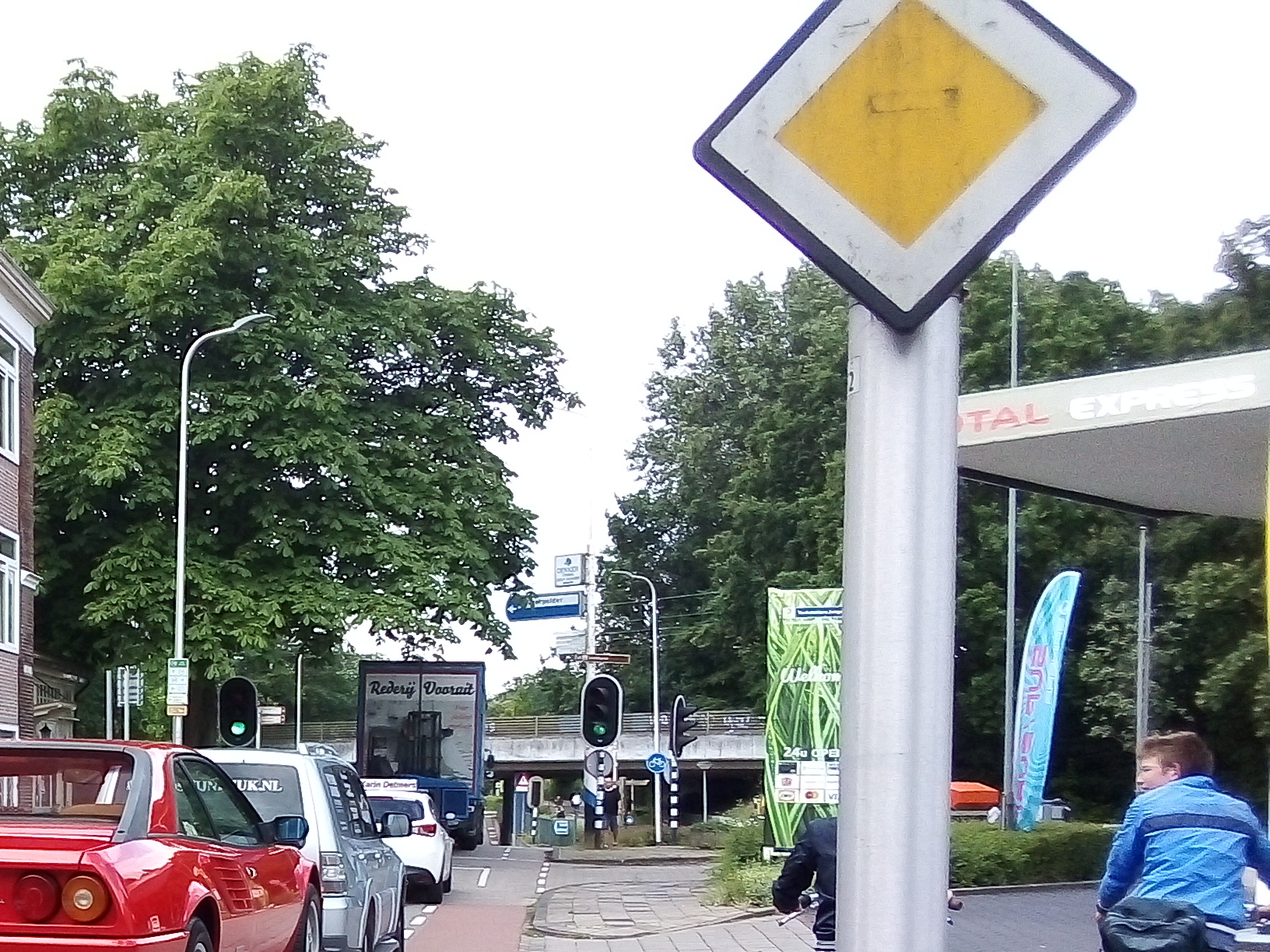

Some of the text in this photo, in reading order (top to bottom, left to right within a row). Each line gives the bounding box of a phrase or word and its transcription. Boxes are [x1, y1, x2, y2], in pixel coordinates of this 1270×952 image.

[958, 374, 1256, 435] TAL EXPRESS
[369, 680, 417, 700] Rederij
[783, 746, 808, 758] 24u
